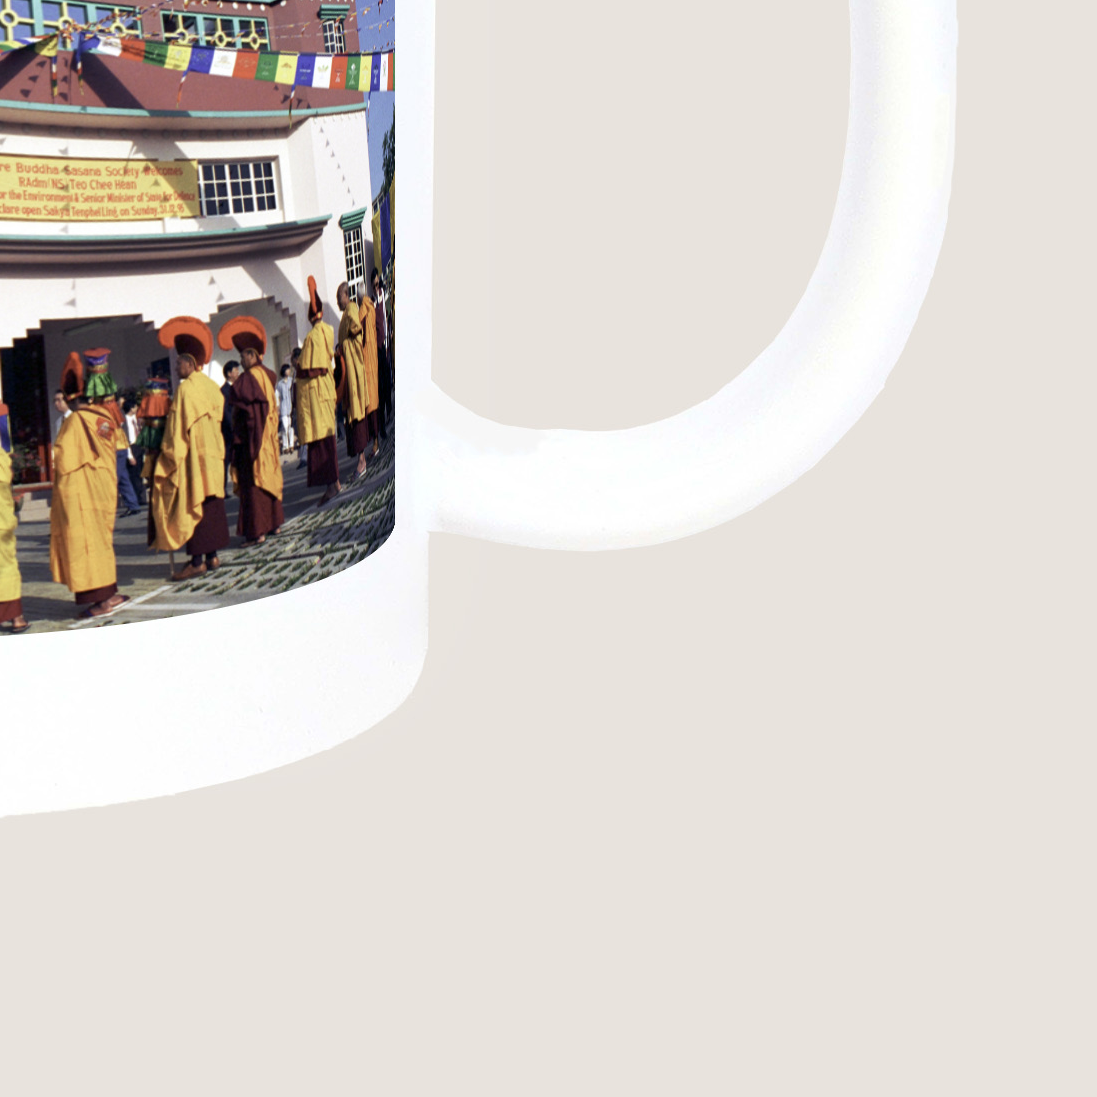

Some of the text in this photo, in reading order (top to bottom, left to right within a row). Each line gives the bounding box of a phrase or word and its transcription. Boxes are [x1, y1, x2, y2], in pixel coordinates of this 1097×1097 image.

[15, 162, 59, 175] Buddha
[63, 164, 102, 177] Sasana
[105, 166, 140, 179] Society
[69, 178, 88, 190] Teo
[89, 179, 113, 190] Chee
[115, 179, 138, 190] Hean
[8, 188, 22, 200] the
[80, 192, 105, 203] Senior
[136, 192, 144, 203] of
[21, 206, 42, 217] open
[119, 207, 130, 217] on
